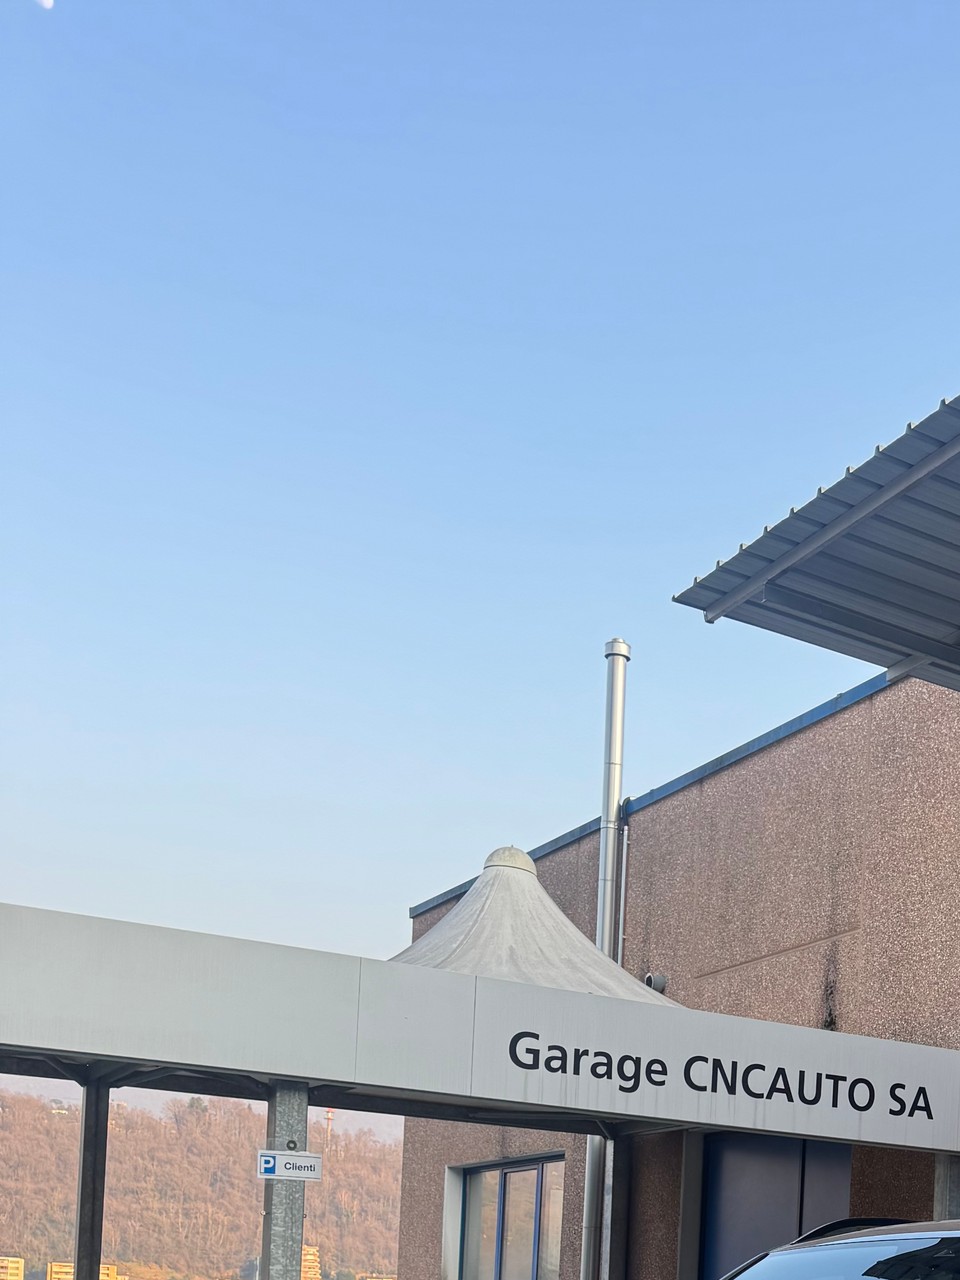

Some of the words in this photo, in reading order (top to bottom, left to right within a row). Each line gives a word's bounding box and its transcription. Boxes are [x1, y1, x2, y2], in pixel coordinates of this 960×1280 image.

[508, 1031, 668, 1093] Garage
[683, 1056, 876, 1112] CNCAUTO
[889, 1083, 934, 1120] SA
[261, 1156, 275, 1173] P
[284, 1162, 316, 1172] Clienti
